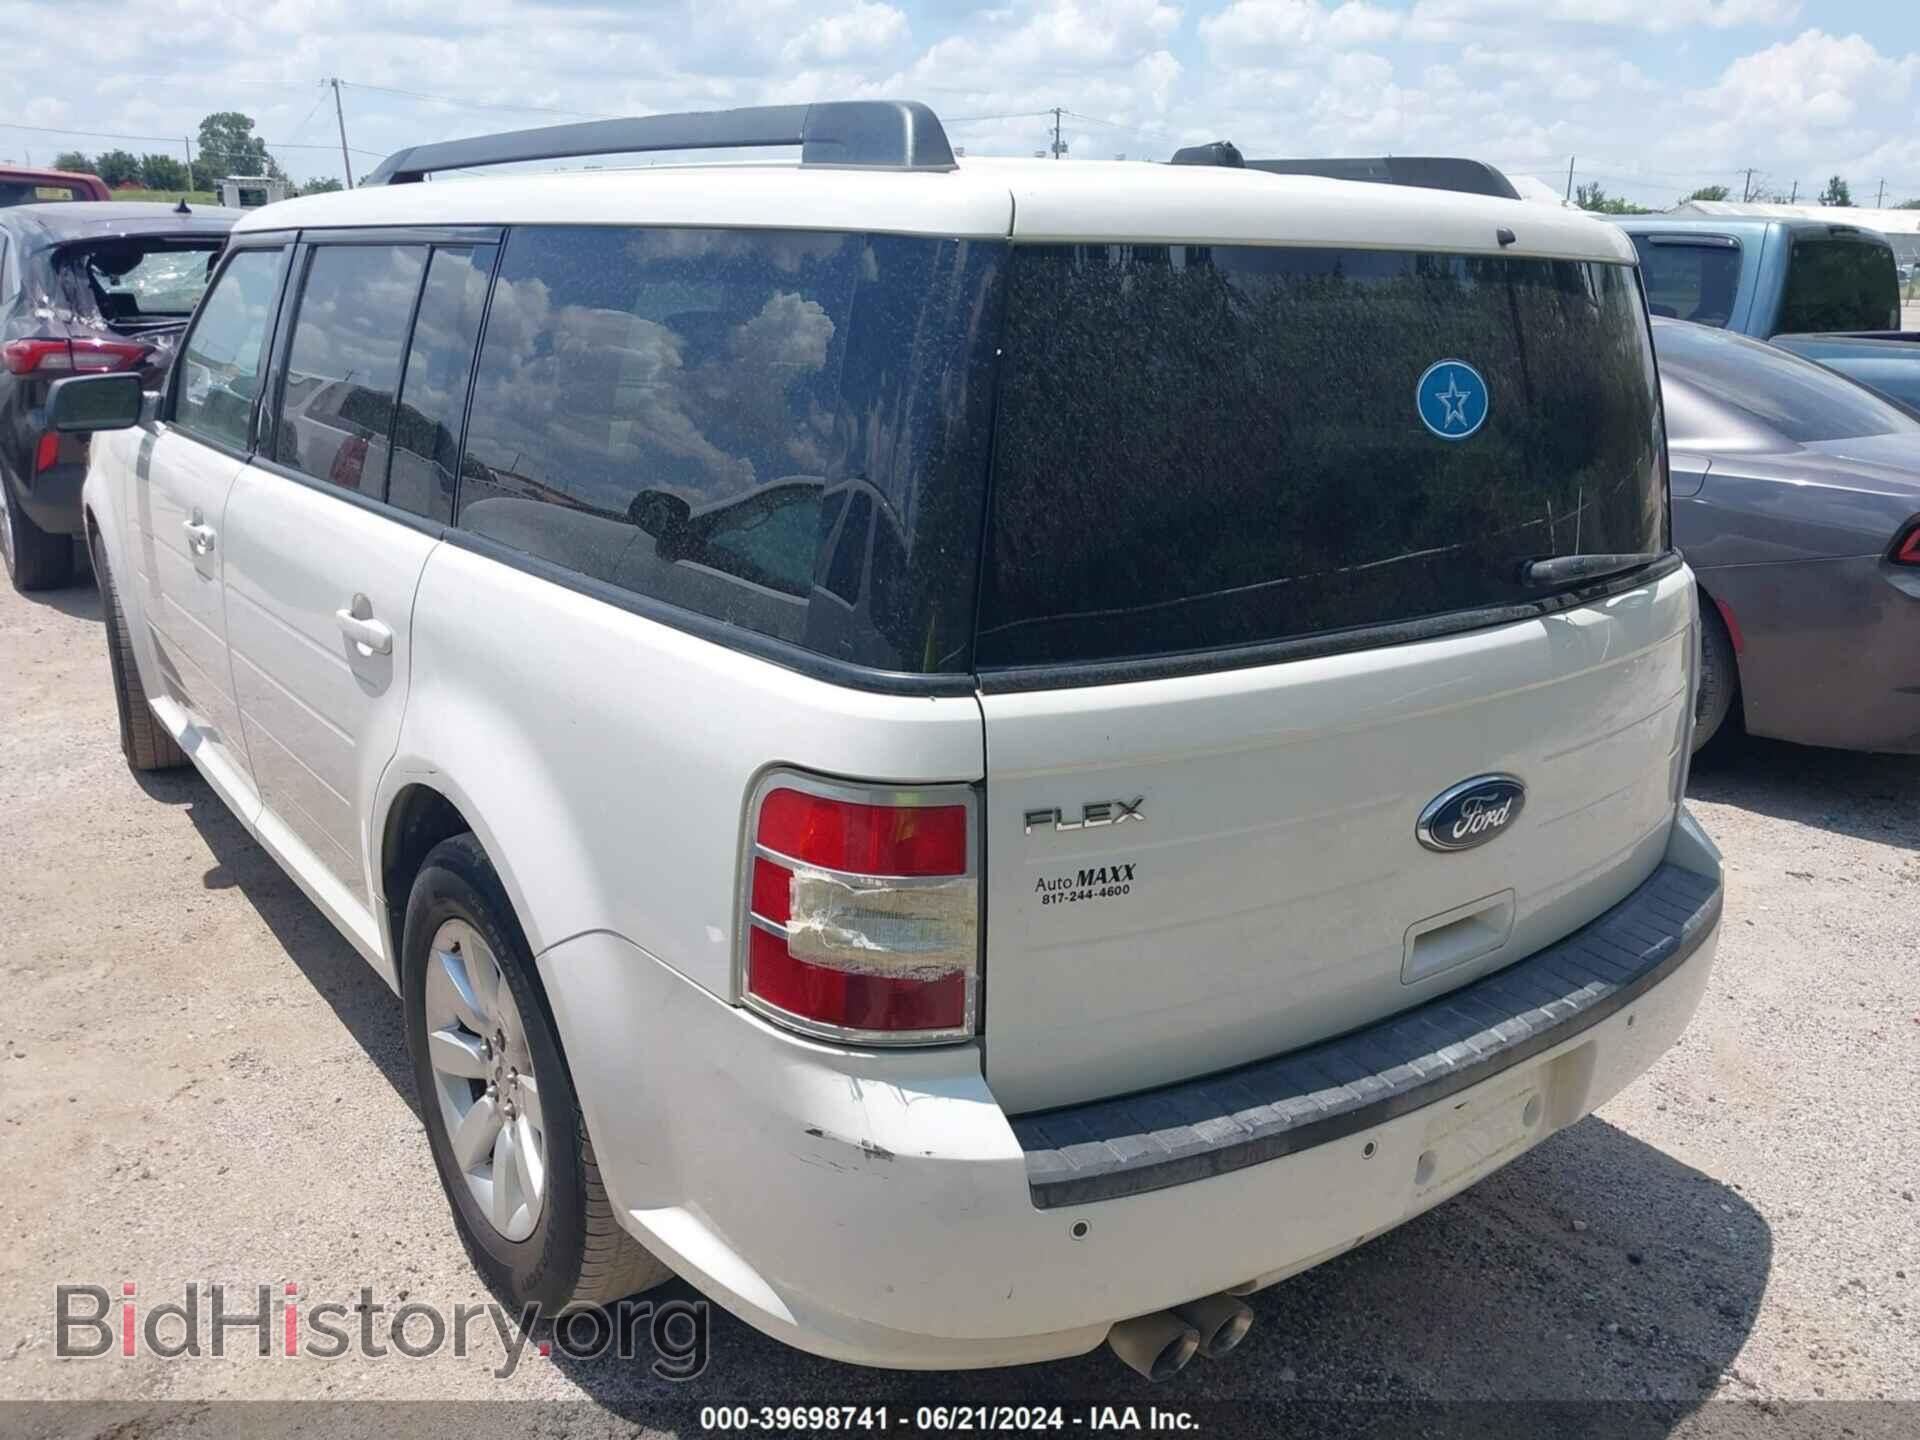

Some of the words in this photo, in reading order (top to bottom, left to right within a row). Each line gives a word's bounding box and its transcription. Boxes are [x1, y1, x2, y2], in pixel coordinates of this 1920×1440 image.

[1024, 796, 1145, 835] FLEX
[1452, 793, 1512, 838] Ford
[1035, 877, 1073, 892] Auto
[1075, 864, 1137, 888] MAXX
[1041, 884, 1131, 905] 817-244-4600
